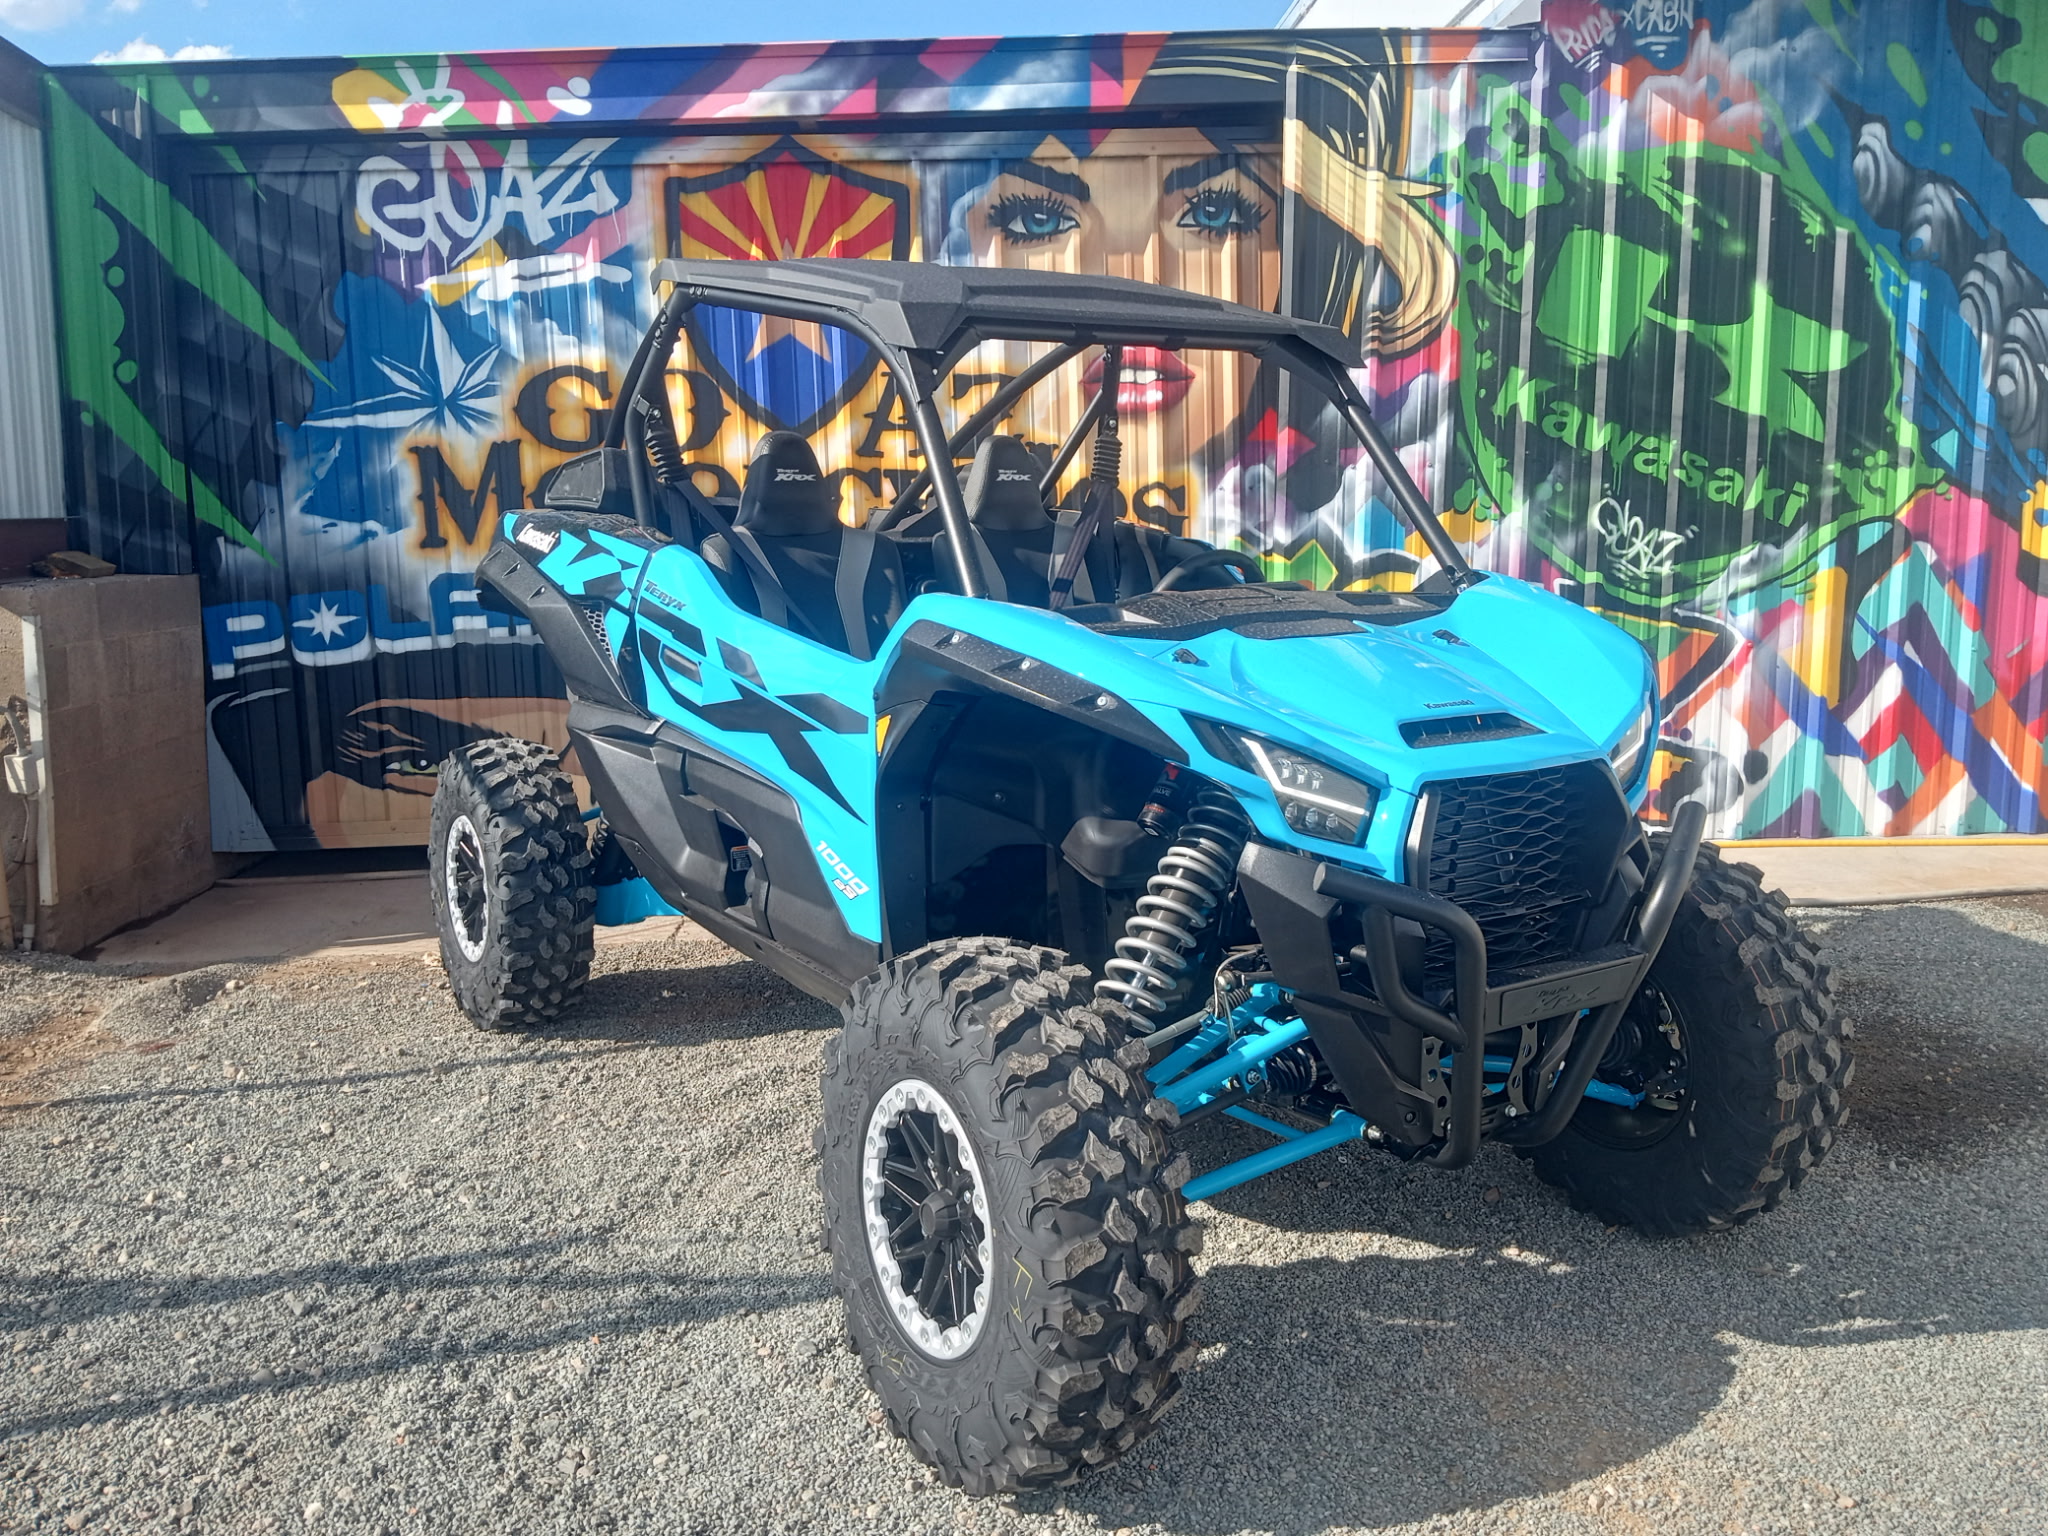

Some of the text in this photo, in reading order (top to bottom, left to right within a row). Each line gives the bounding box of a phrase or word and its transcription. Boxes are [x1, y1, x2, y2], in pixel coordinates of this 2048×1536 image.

[1492, 366, 1810, 528] Kawasaki
[202, 573, 536, 681] POLA
[1423, 699, 1476, 710] Kawasaki
[816, 840, 871, 895] 1000
